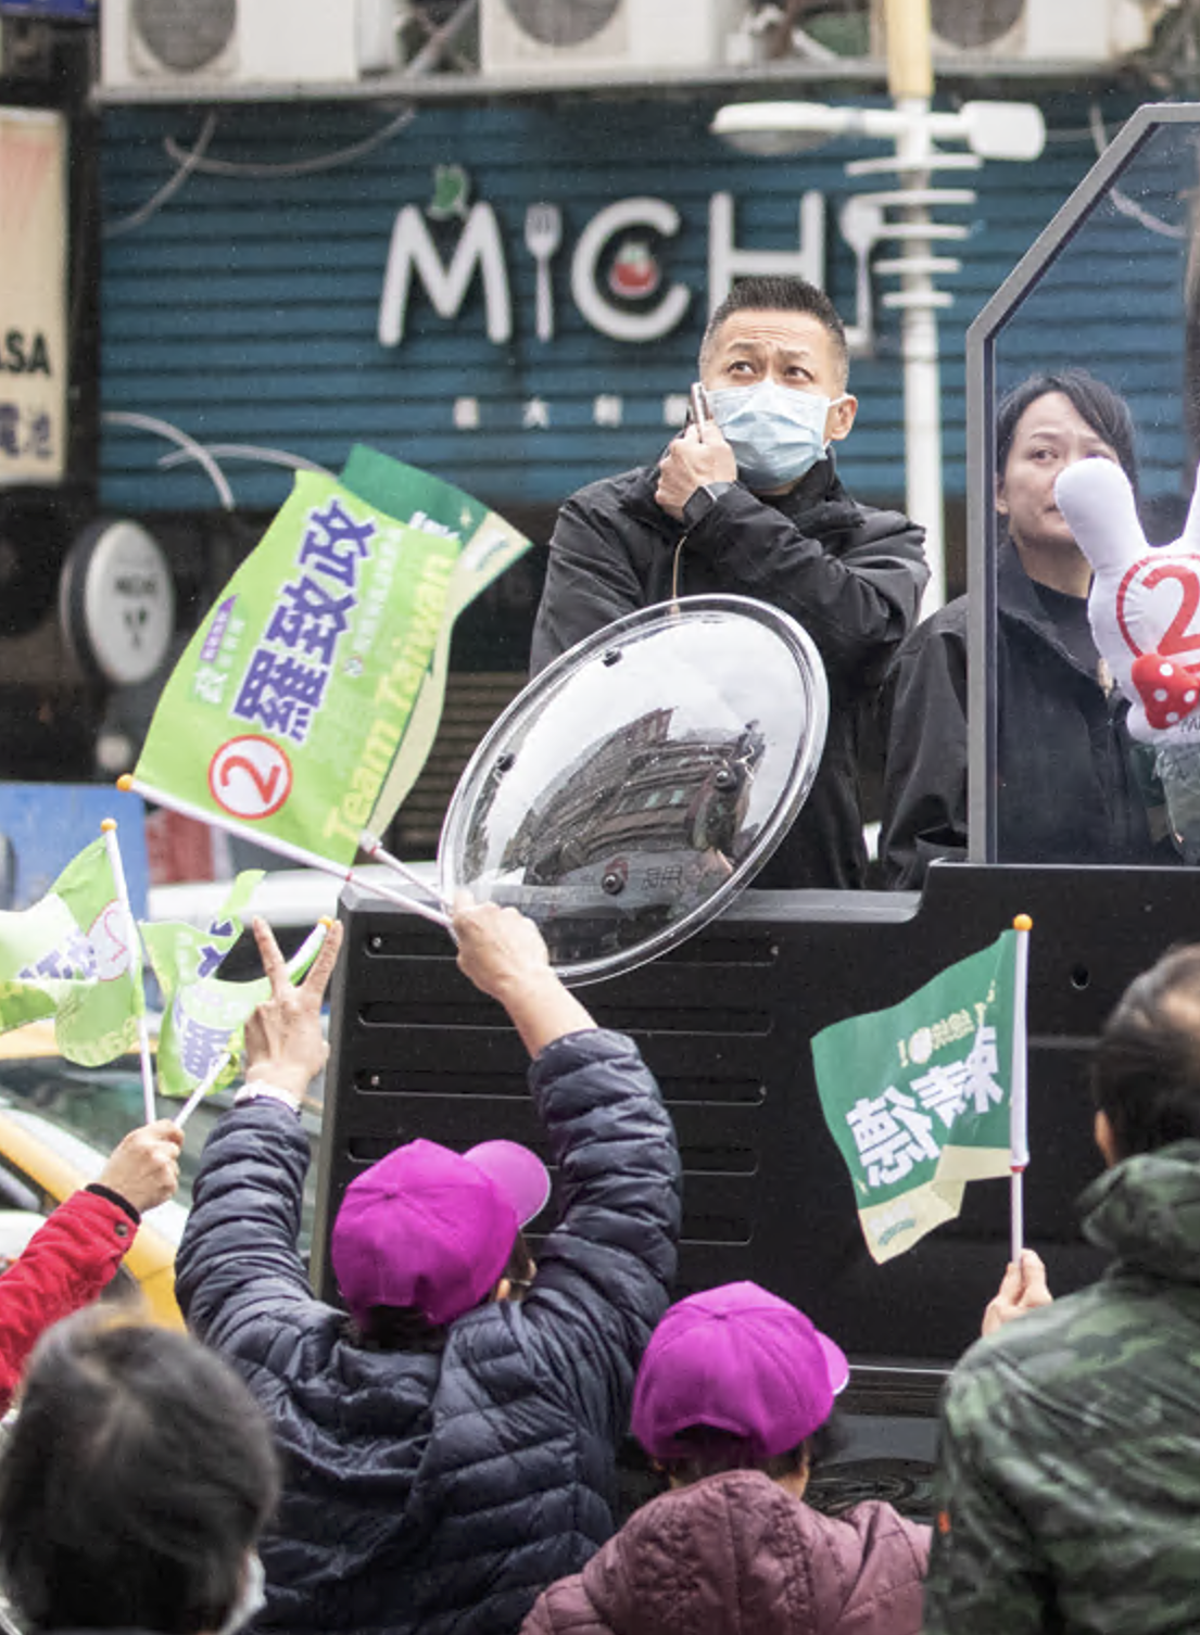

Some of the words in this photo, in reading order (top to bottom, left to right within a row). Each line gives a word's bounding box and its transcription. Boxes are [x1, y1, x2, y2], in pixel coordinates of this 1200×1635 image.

[0, 329, 51, 376] SA
[231, 498, 377, 744] 羅致政
[323, 716, 397, 841] Team
[376, 553, 455, 711] Taiwan
